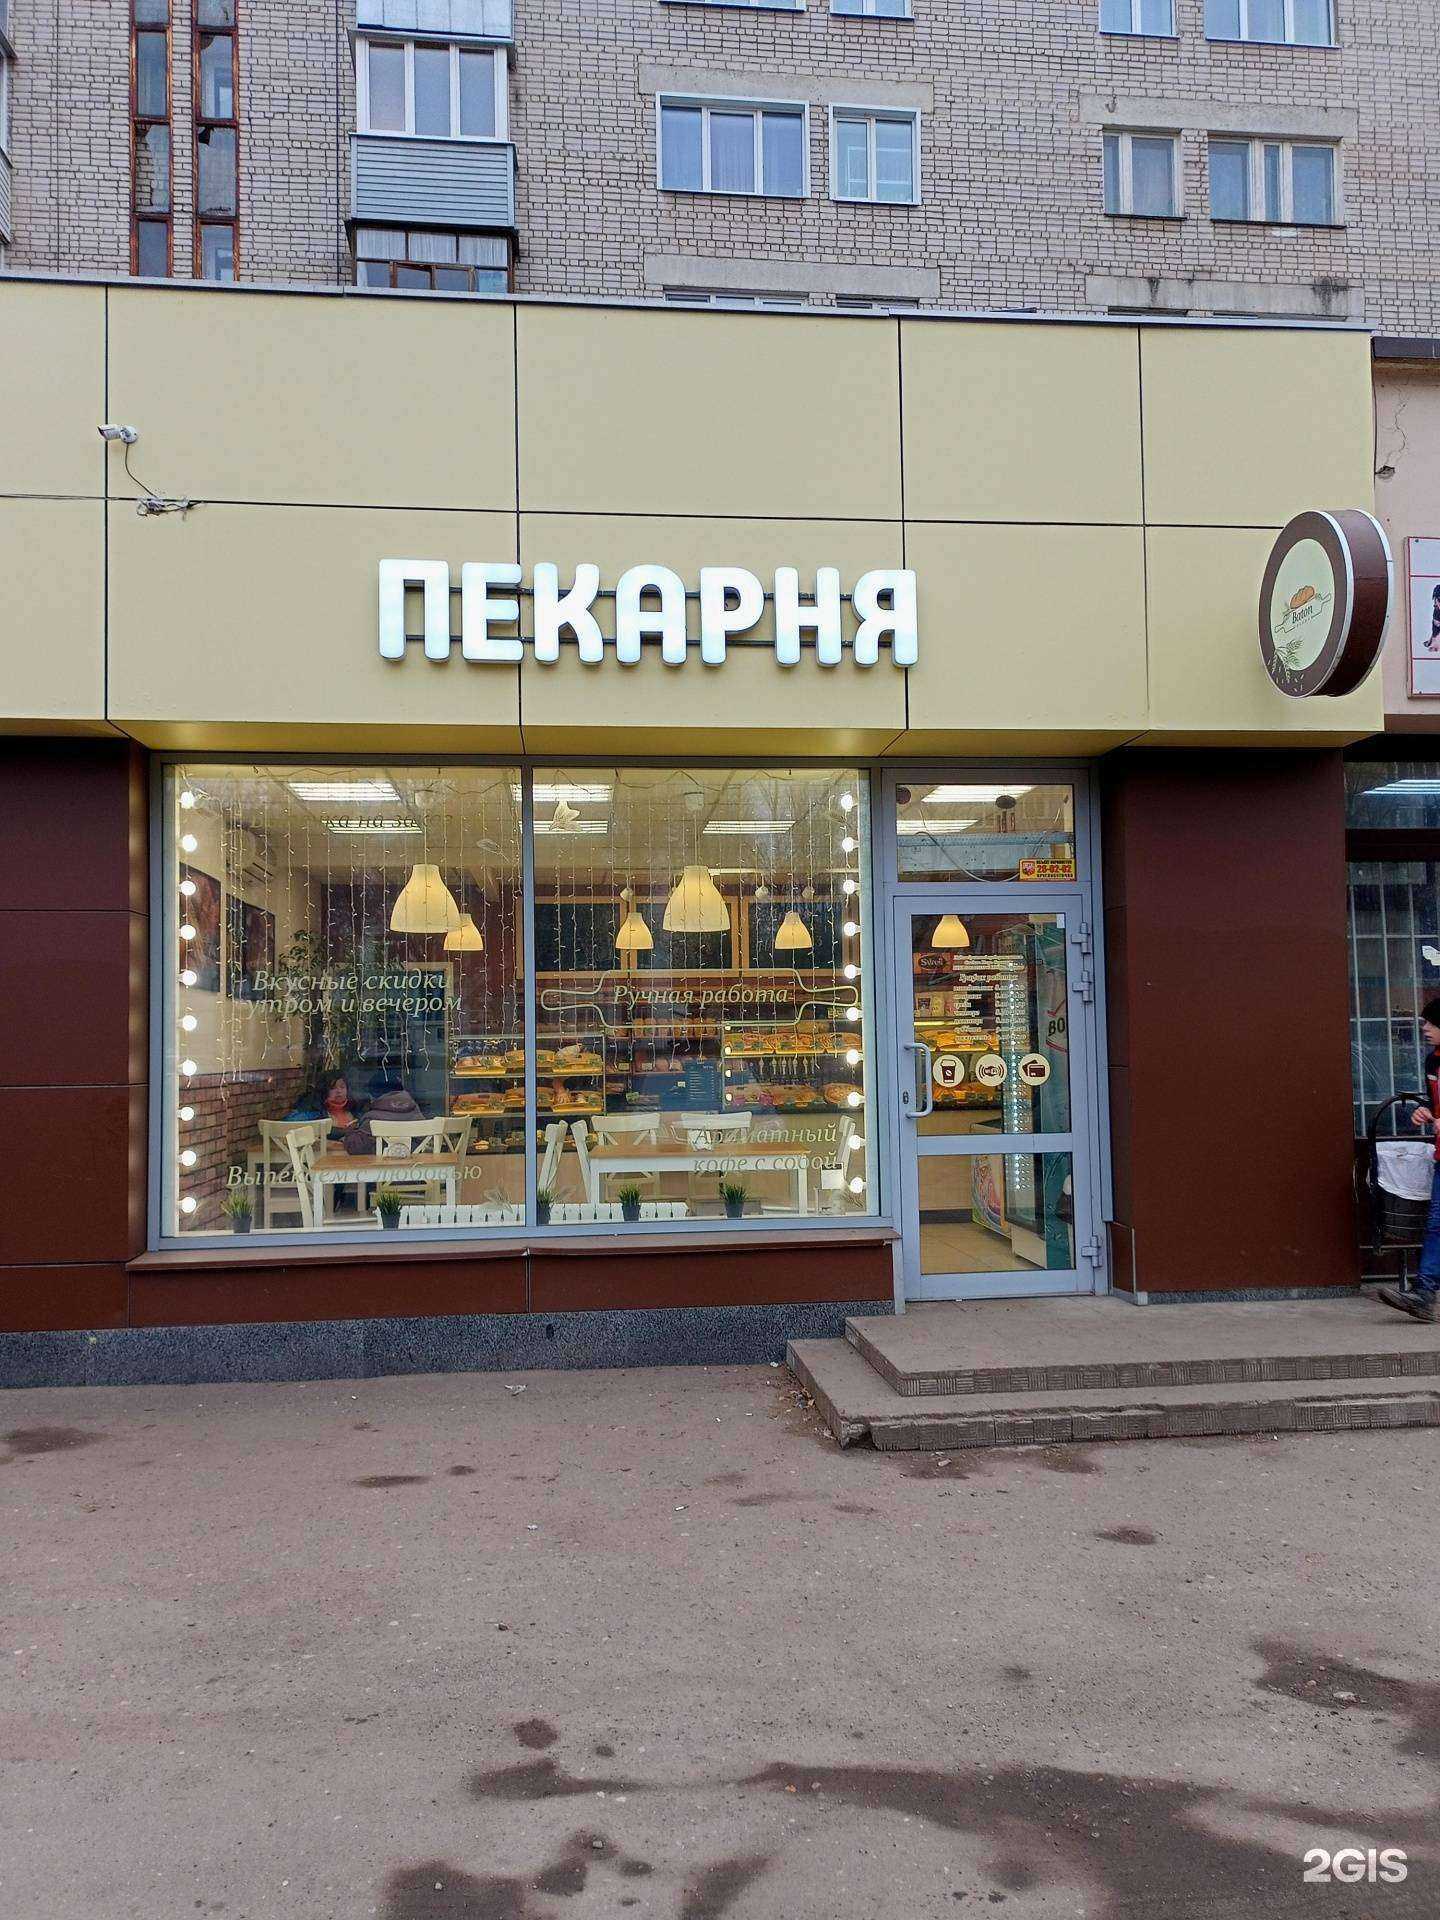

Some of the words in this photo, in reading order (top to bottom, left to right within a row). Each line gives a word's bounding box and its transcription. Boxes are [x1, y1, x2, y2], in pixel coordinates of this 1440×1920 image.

[378, 559, 918, 667] ПЕКАРНЯ
[252, 969, 359, 997] Вкусные
[365, 968, 451, 991] скидки
[248, 997, 332, 1020] утром
[341, 997, 355, 1013] и
[363, 997, 462, 1018] вечером
[613, 984, 693, 1009] Ручная
[699, 984, 789, 1009] работа
[693, 1123, 837, 1146] Ароматный
[694, 1153, 748, 1178] кофе
[773, 1151, 838, 1171] собой
